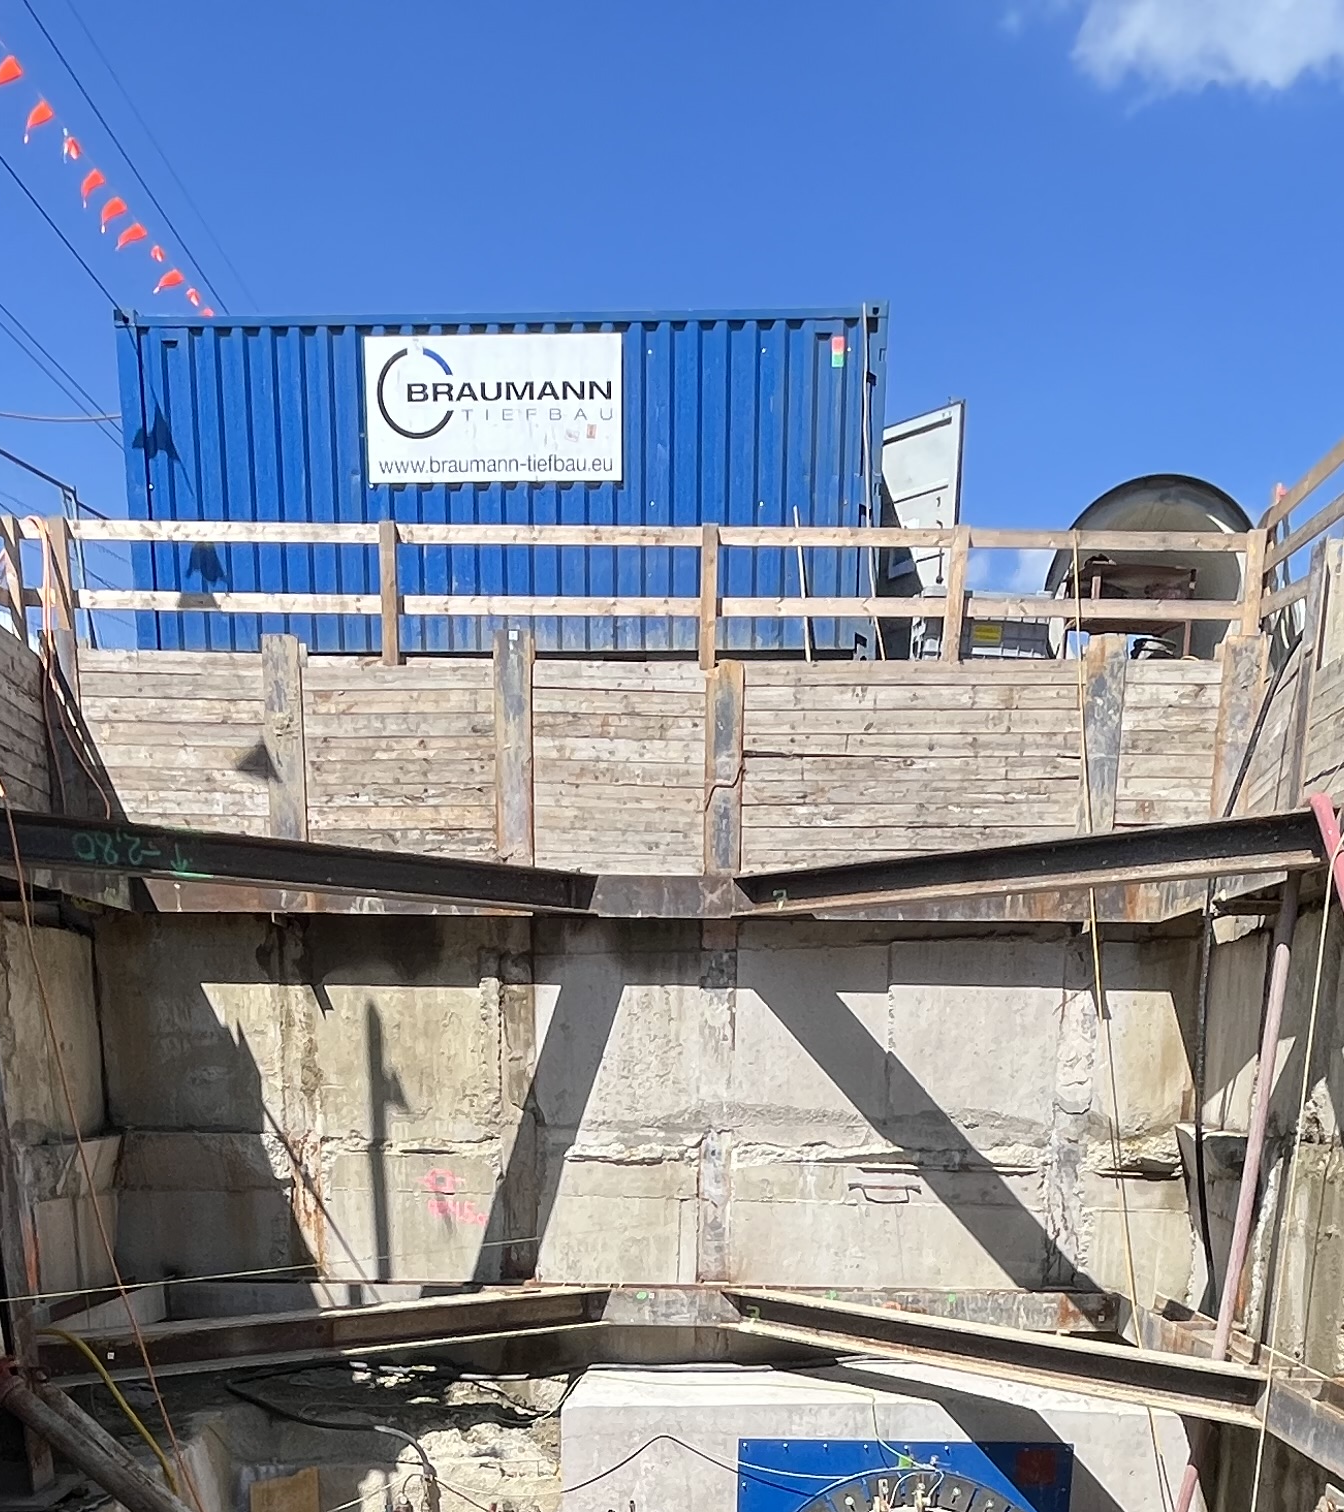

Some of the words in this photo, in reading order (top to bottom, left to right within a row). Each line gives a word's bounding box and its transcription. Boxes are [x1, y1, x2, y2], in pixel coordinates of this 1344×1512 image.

[406, 380, 613, 403] BRAUMANN
[461, 407, 613, 421] TIEFBAU
[379, 453, 613, 475] www.braumann-tiefbau.eu
